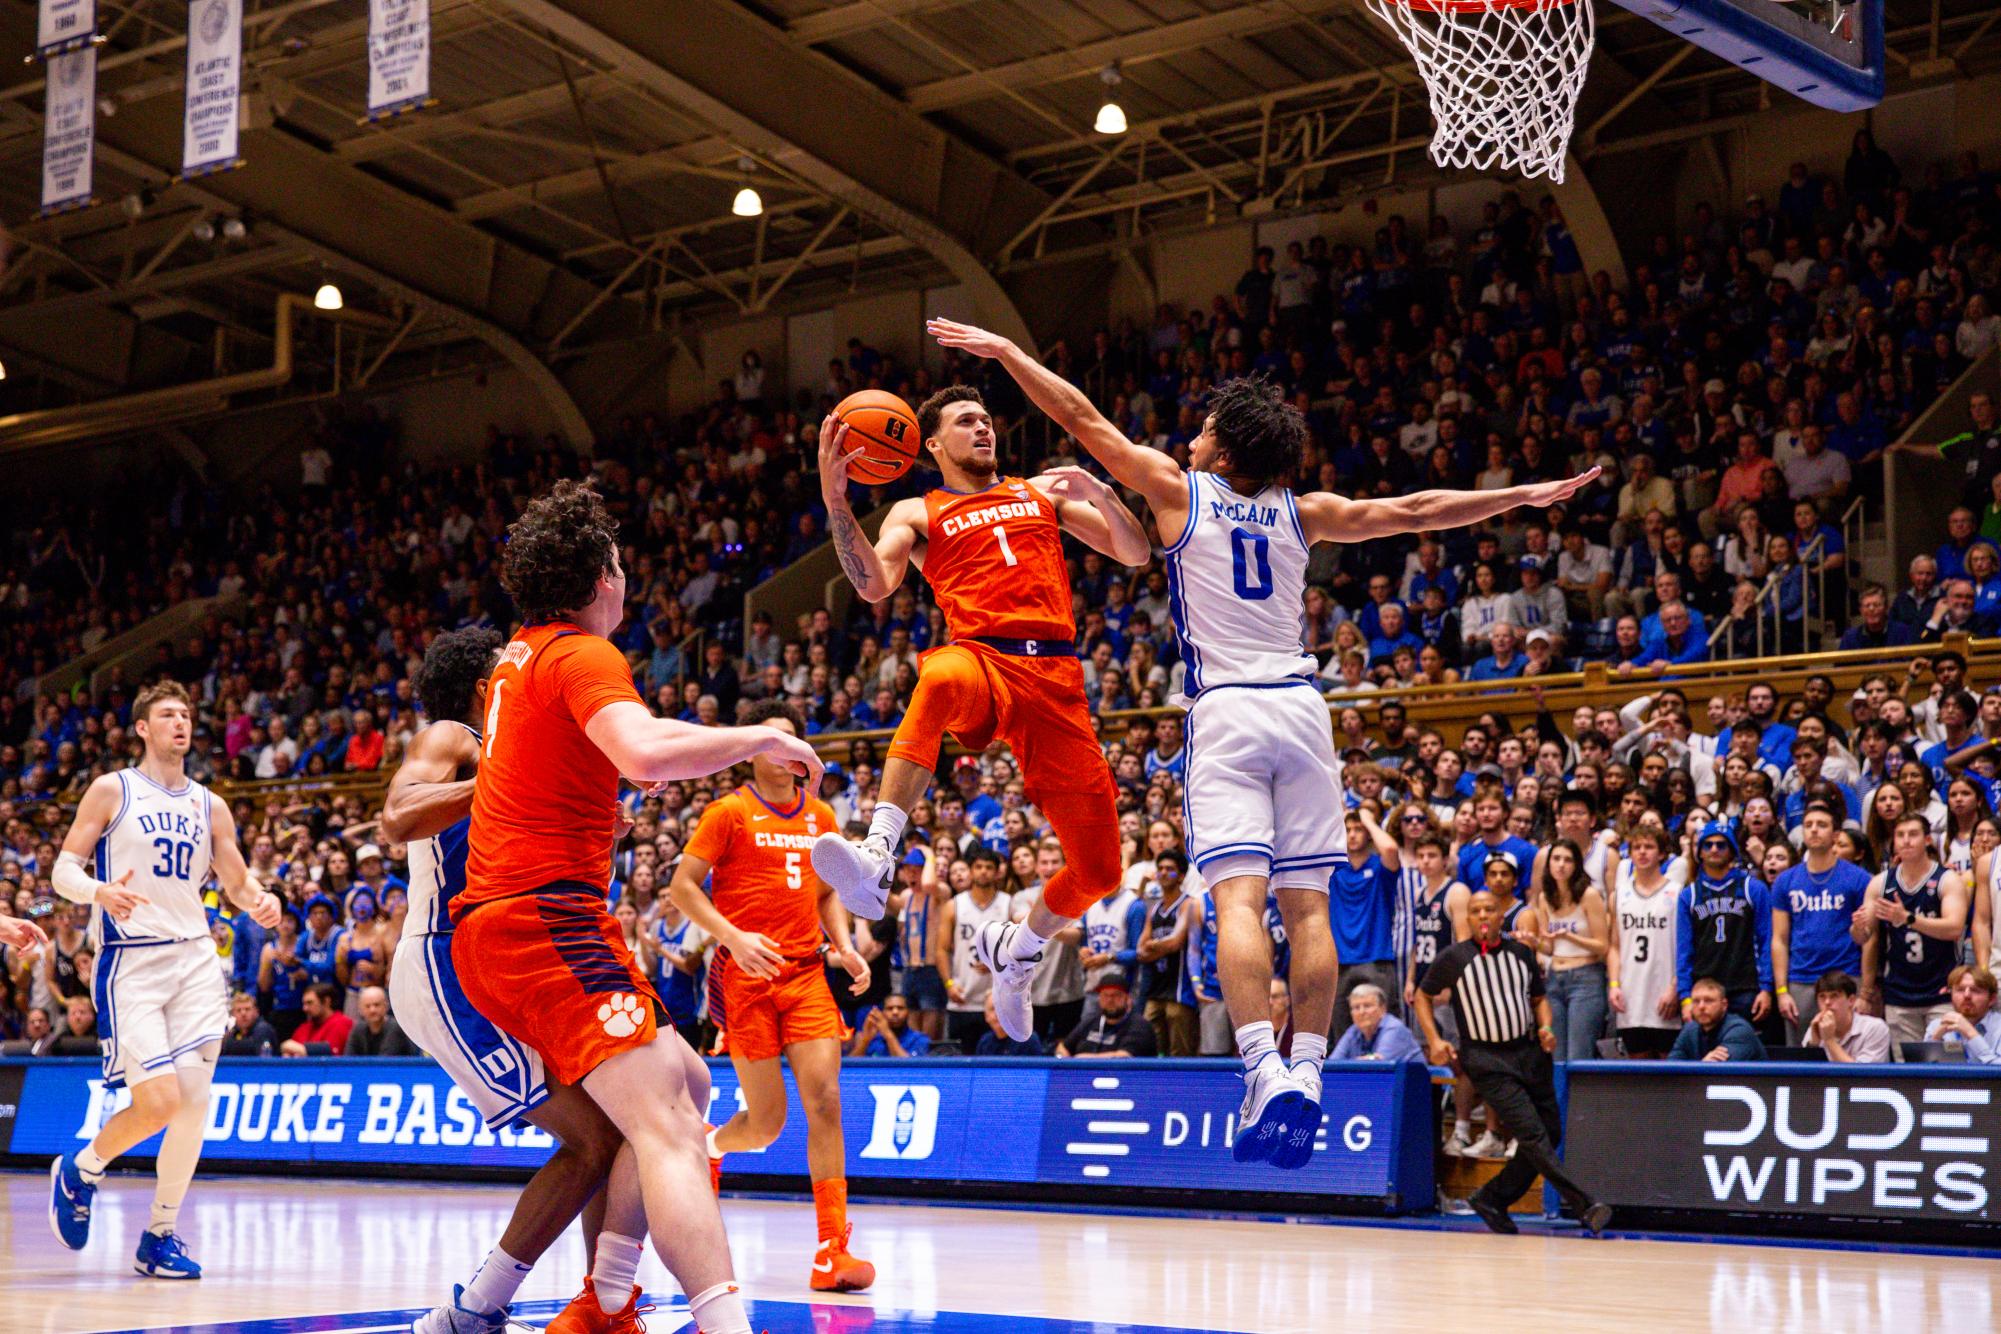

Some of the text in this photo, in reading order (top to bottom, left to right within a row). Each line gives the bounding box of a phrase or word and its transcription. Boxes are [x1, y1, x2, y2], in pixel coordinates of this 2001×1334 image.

[942, 501, 1041, 537] CLEMSON
[992, 526, 1018, 567] 1
[1231, 527, 1274, 600] 0
[1026, 640, 1038, 655] C
[138, 812, 203, 846] DUKE
[755, 832, 818, 849] CLEMSO
[153, 837, 194, 880] 30
[785, 852, 802, 890] 5
[1695, 896, 1748, 921] DUKE
[1788, 889, 1846, 914] Duke
[1622, 912, 1668, 930] Duke
[1714, 915, 1726, 943] 1
[1416, 934, 1437, 964] 33
[1634, 935, 1649, 963] 3
[1904, 931, 1924, 964] 3
[202, 1083, 353, 1143] DUKE
[1703, 1085, 1990, 1153] DUDE
[1702, 1154, 1989, 1212] WIPES
